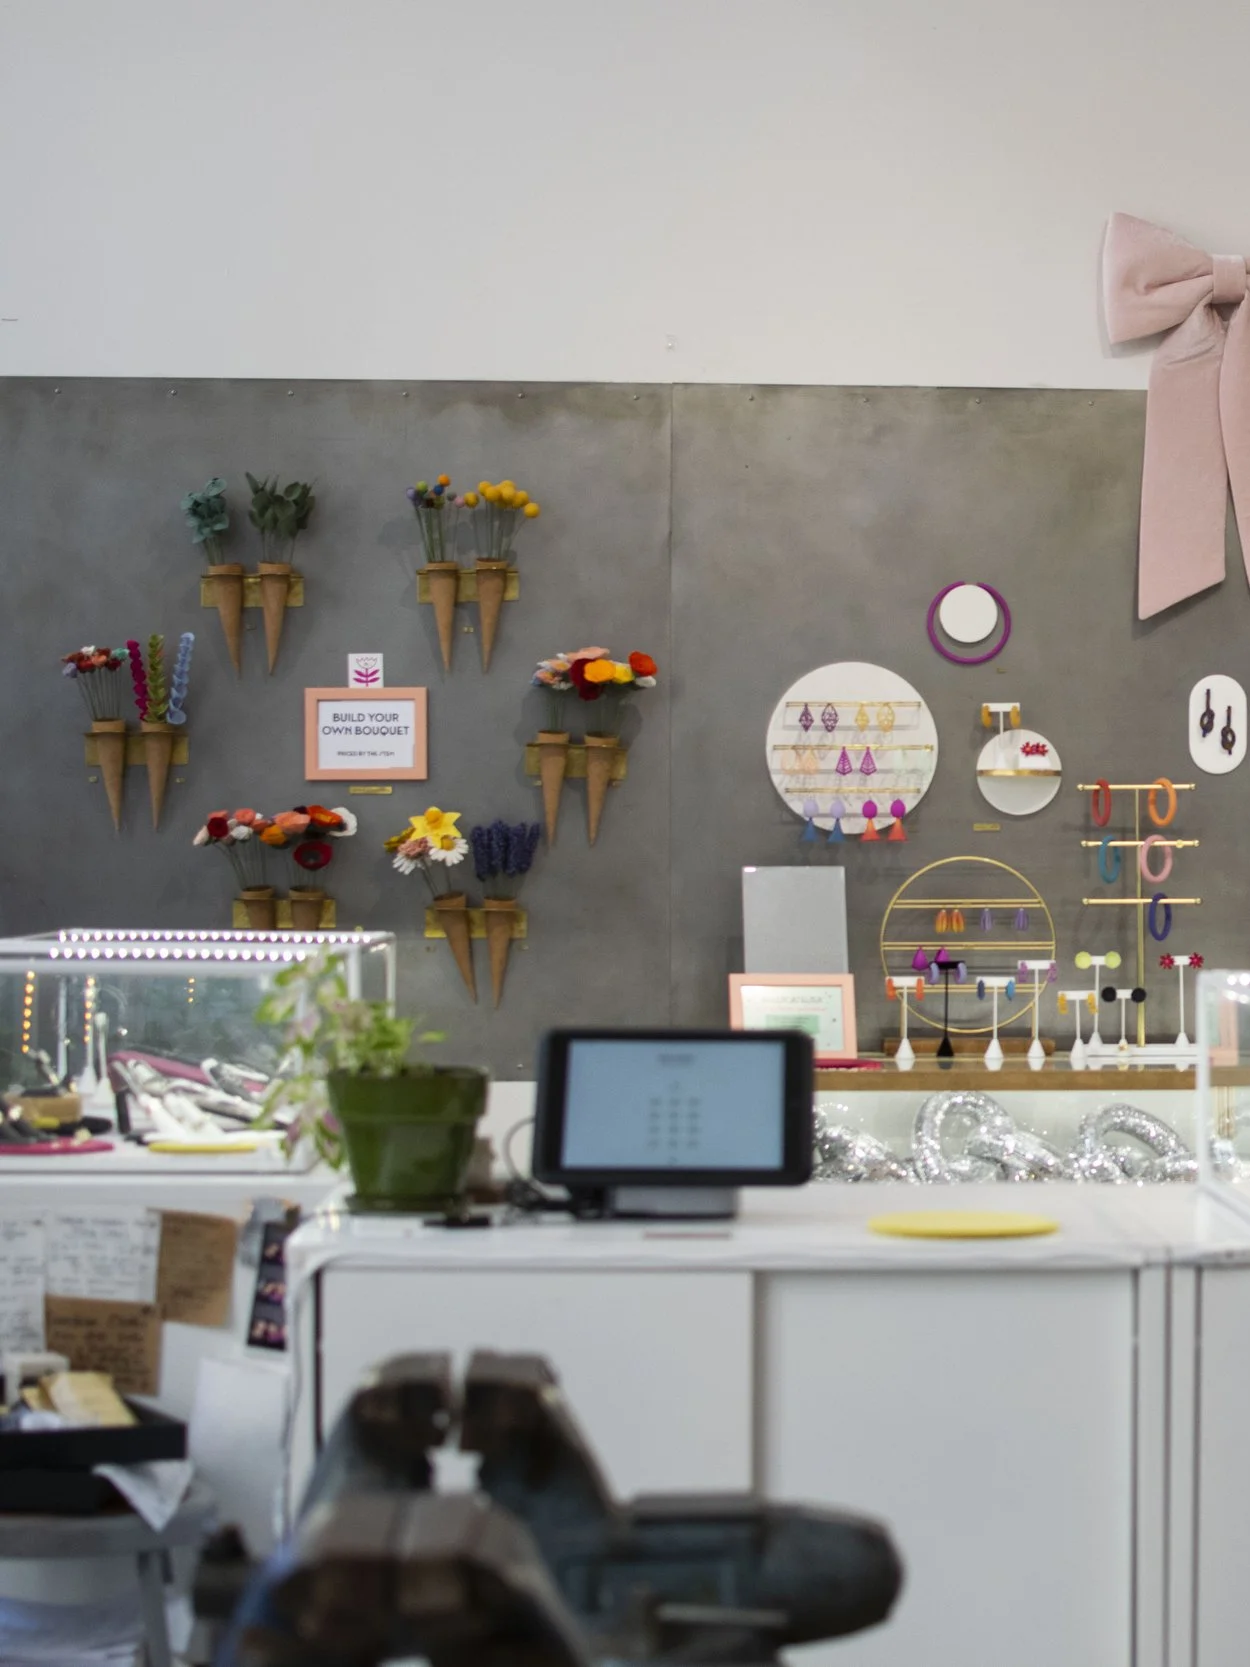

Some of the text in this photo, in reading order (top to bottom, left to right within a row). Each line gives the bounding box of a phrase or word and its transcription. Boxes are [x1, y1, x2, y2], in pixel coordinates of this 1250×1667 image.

[333, 713, 399, 722] BUILD YOUR
[322, 726, 410, 736] OWN BOUQUET
